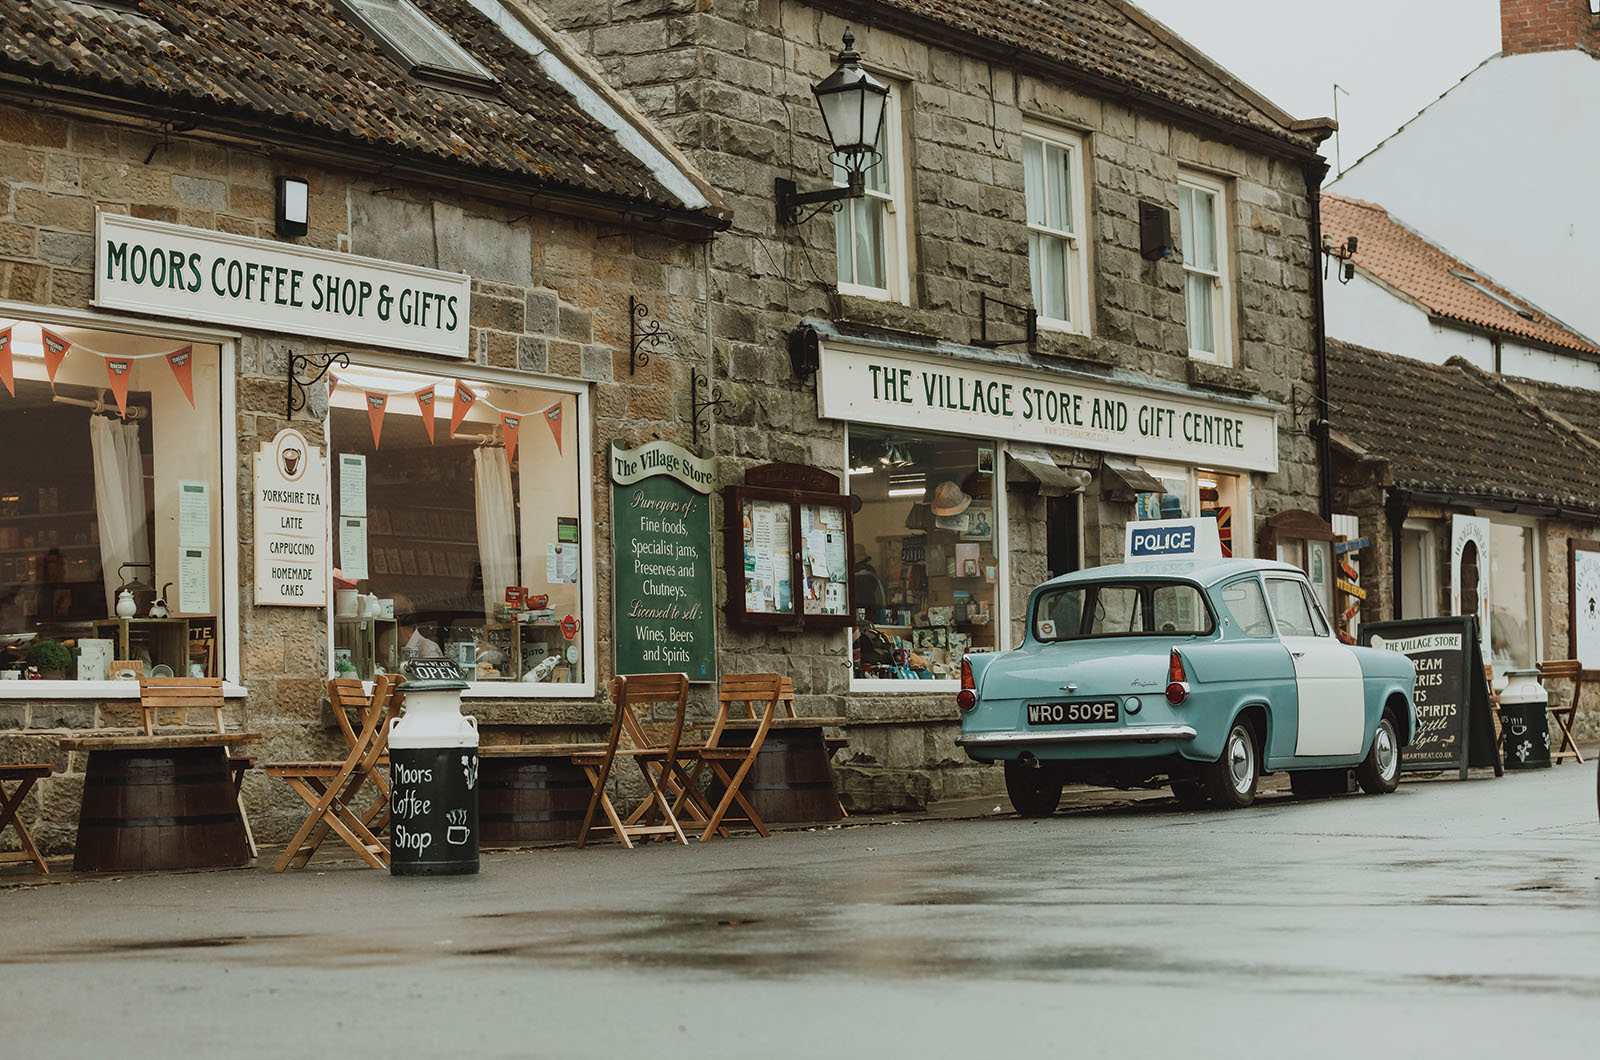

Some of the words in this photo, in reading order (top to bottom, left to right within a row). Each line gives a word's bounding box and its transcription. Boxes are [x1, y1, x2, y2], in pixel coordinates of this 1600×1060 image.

[106, 240, 201, 292] MOORS
[211, 257, 303, 308] COFFEE
[311, 273, 373, 317] SHOP
[377, 284, 394, 321] &
[400, 288, 458, 331] GIFTS
[868, 364, 913, 403] THE
[922, 372, 1014, 417] VILLAGE
[1023, 386, 1083, 427] STORE
[1091, 398, 1128, 432] AND
[1138, 405, 1174, 439] GIFT
[1183, 411, 1244, 449] CENTRE
[614, 457, 638, 477] The
[639, 448, 680, 474] Village
[682, 459, 713, 484] Store
[262, 489, 304, 505] YORKSHIRE
[307, 492, 321, 506] TEA
[630, 489, 680, 516] Purveyors
[280, 516, 303, 530] LATTE
[640, 516, 660, 533] Fine
[661, 519, 689, 537] foods,
[269, 541, 315, 556] CAPPUCCINO
[631, 537, 674, 559] Specialist
[675, 541, 699, 561] jams,
[1134, 532, 1192, 551] POLICE
[271, 567, 313, 581] HOMEMADE
[634, 559, 676, 578] Preserves
[677, 561, 695, 577] and
[280, 584, 304, 596] CAKES
[642, 579, 687, 601] Chutneys.
[627, 599, 670, 619] Licensed
[670, 604, 680, 619] to
[635, 625, 667, 644] Wines,
[669, 625, 694, 643] Beers
[1385, 641, 1399, 652] THE
[1400, 637, 1432, 651] VILLAGE
[1434, 636, 1459, 647] STORE
[642, 646, 661, 662] and
[661, 647, 690, 666] Spirits
[1412, 658, 1443, 671] REAM
[416, 666, 461, 679] OPEN
[1415, 673, 1443, 687] RIES
[1413, 689, 1427, 702] TS
[1028, 703, 1064, 723] WRO
[1067, 702, 1117, 721] 509E
[1416, 703, 1457, 718] SPIRITS
[1410, 732, 1439, 750] lgia
[1401, 752, 1453, 760] HEARTBEAT.CO.UK
[394, 763, 433, 785] Moors
[391, 789, 432, 820] Coffee
[394, 824, 432, 858] Shop
